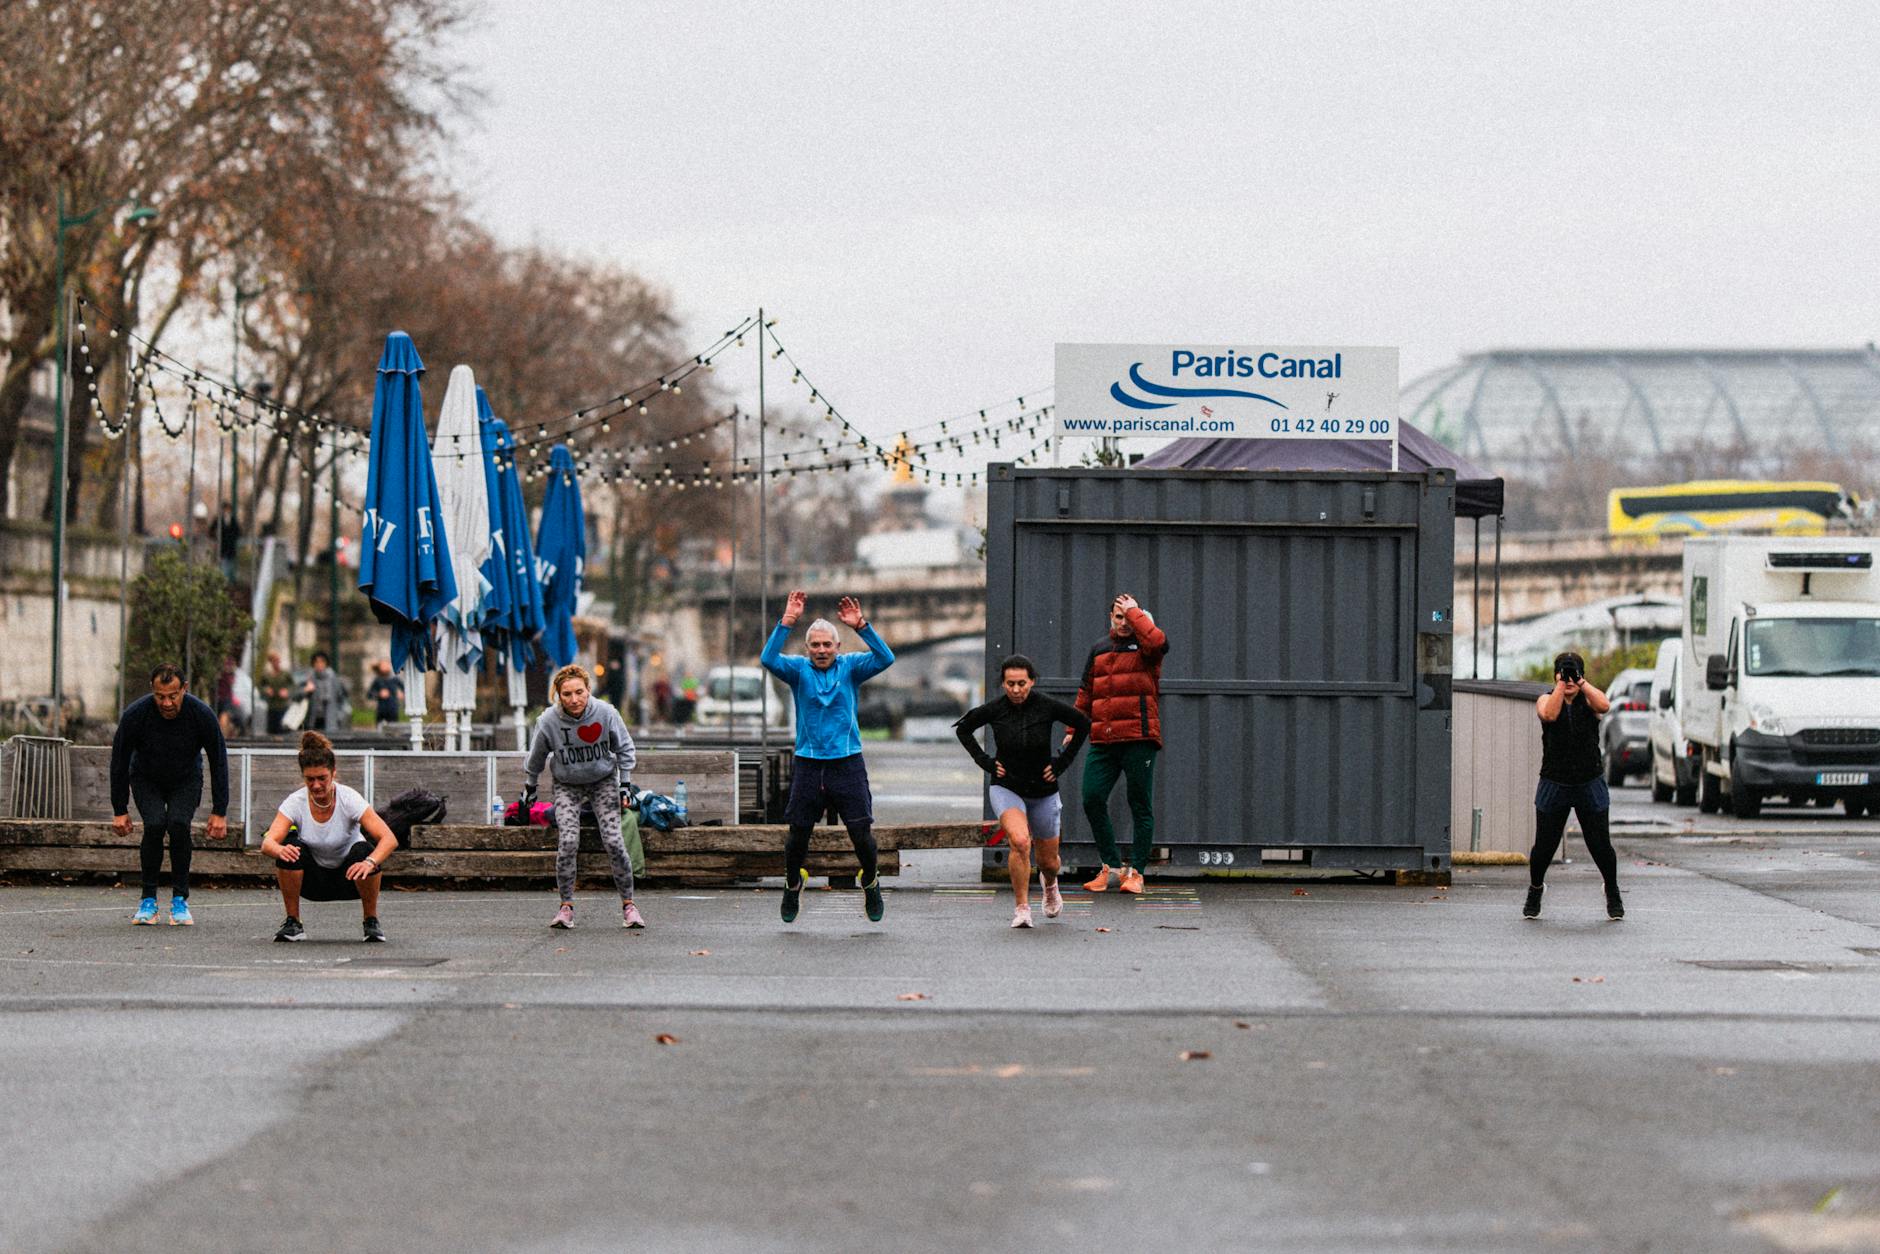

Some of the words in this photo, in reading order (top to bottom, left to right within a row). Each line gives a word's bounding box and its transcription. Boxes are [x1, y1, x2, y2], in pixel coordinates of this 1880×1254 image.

[1063, 416, 1235, 434] www.pariscanal.com
[1270, 418, 1290, 433] 01
[1295, 418, 1315, 433] 42
[1320, 419, 1340, 433] 40
[1345, 419, 1365, 434] 29
[1369, 419, 1390, 434] 00
[560, 727, 573, 746] I
[559, 740, 608, 765] LONDON
